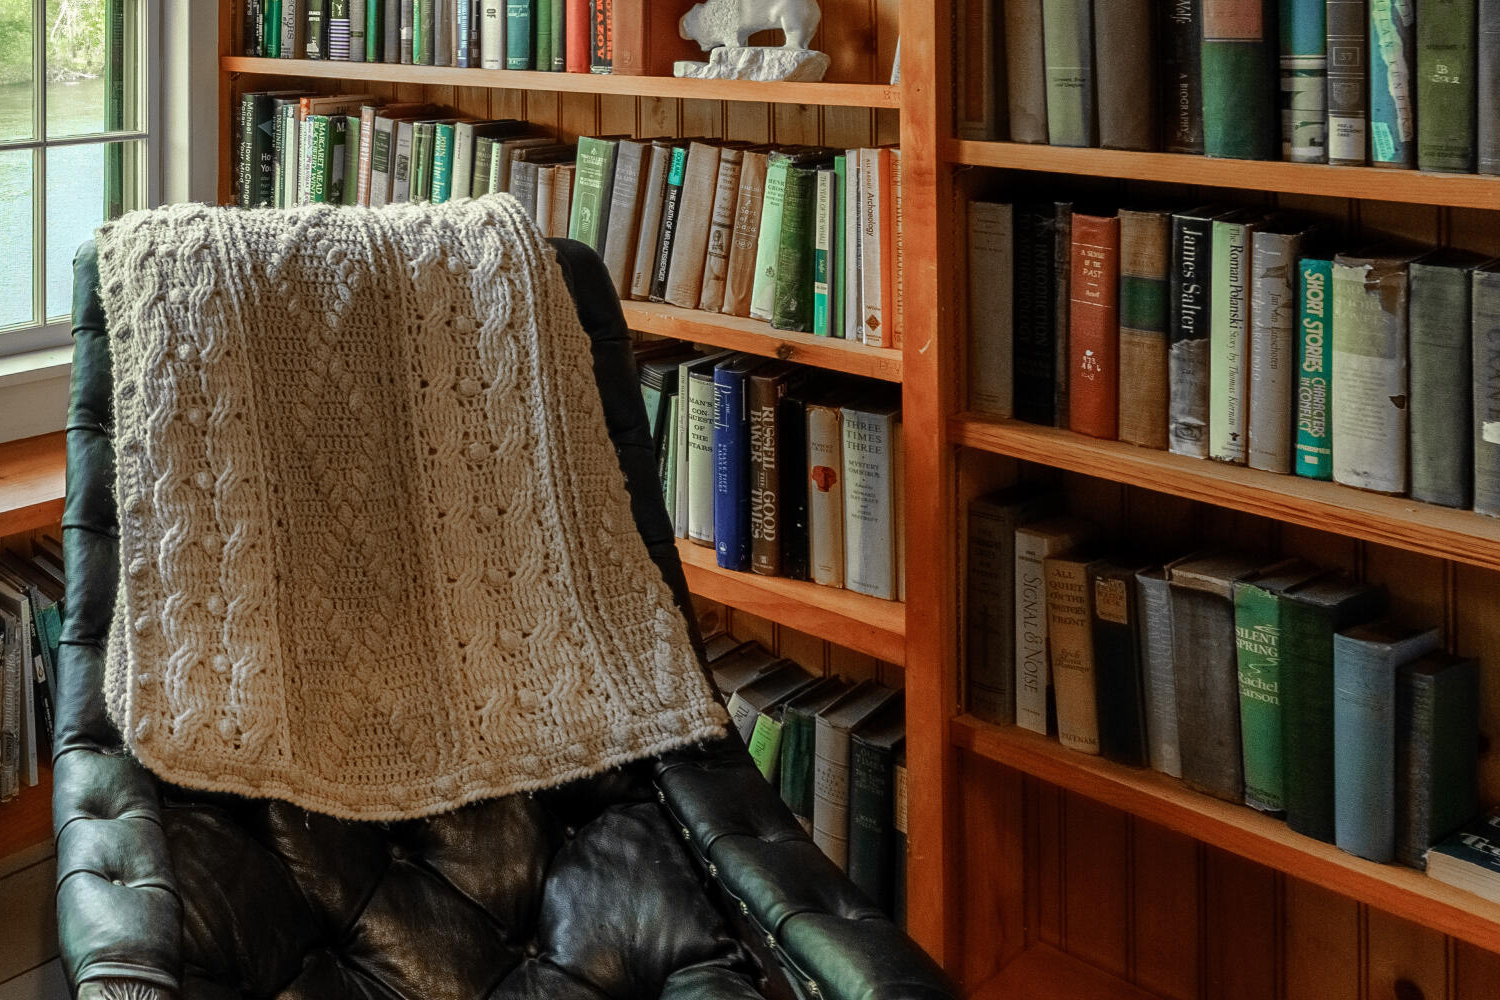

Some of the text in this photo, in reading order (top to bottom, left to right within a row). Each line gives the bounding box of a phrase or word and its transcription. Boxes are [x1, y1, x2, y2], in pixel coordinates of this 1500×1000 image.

[486, 8, 495, 19] OF
[1179, 83, 1188, 133] BIOGRAPHY
[242, 101, 253, 204] Michael How to Change
[315, 122, 325, 194] MARGARET MEAD
[664, 188, 676, 229] THE DEATH OF
[865, 192, 875, 236] Archaeology
[1082, 268, 1102, 280] PAST
[1180, 226, 1202, 334] James Salter
[1227, 244, 1243, 329] Roman Polanski
[1302, 269, 1324, 371] SHORT STORIES
[690, 397, 713, 408] MAN'S
[1298, 387, 1311, 431] CONFLICT
[1312, 377, 1325, 436] CHARACTERS
[688, 442, 713, 452] STARS
[692, 432, 709, 442] THE
[750, 410, 762, 462] BAKER
[762, 406, 775, 470] RUSSELL
[846, 418, 882, 434] THREE
[846, 430, 882, 444] TIMES
[846, 440, 882, 454] THREE
[752, 488, 764, 540] TIMES
[763, 490, 776, 542] GOOD
[1048, 579, 1085, 592] QUIET
[1052, 568, 1076, 580] ALL
[1022, 573, 1040, 692] SIGNAL NOISE
[1052, 614, 1087, 628] FRONT
[1236, 628, 1280, 646] SILENT
